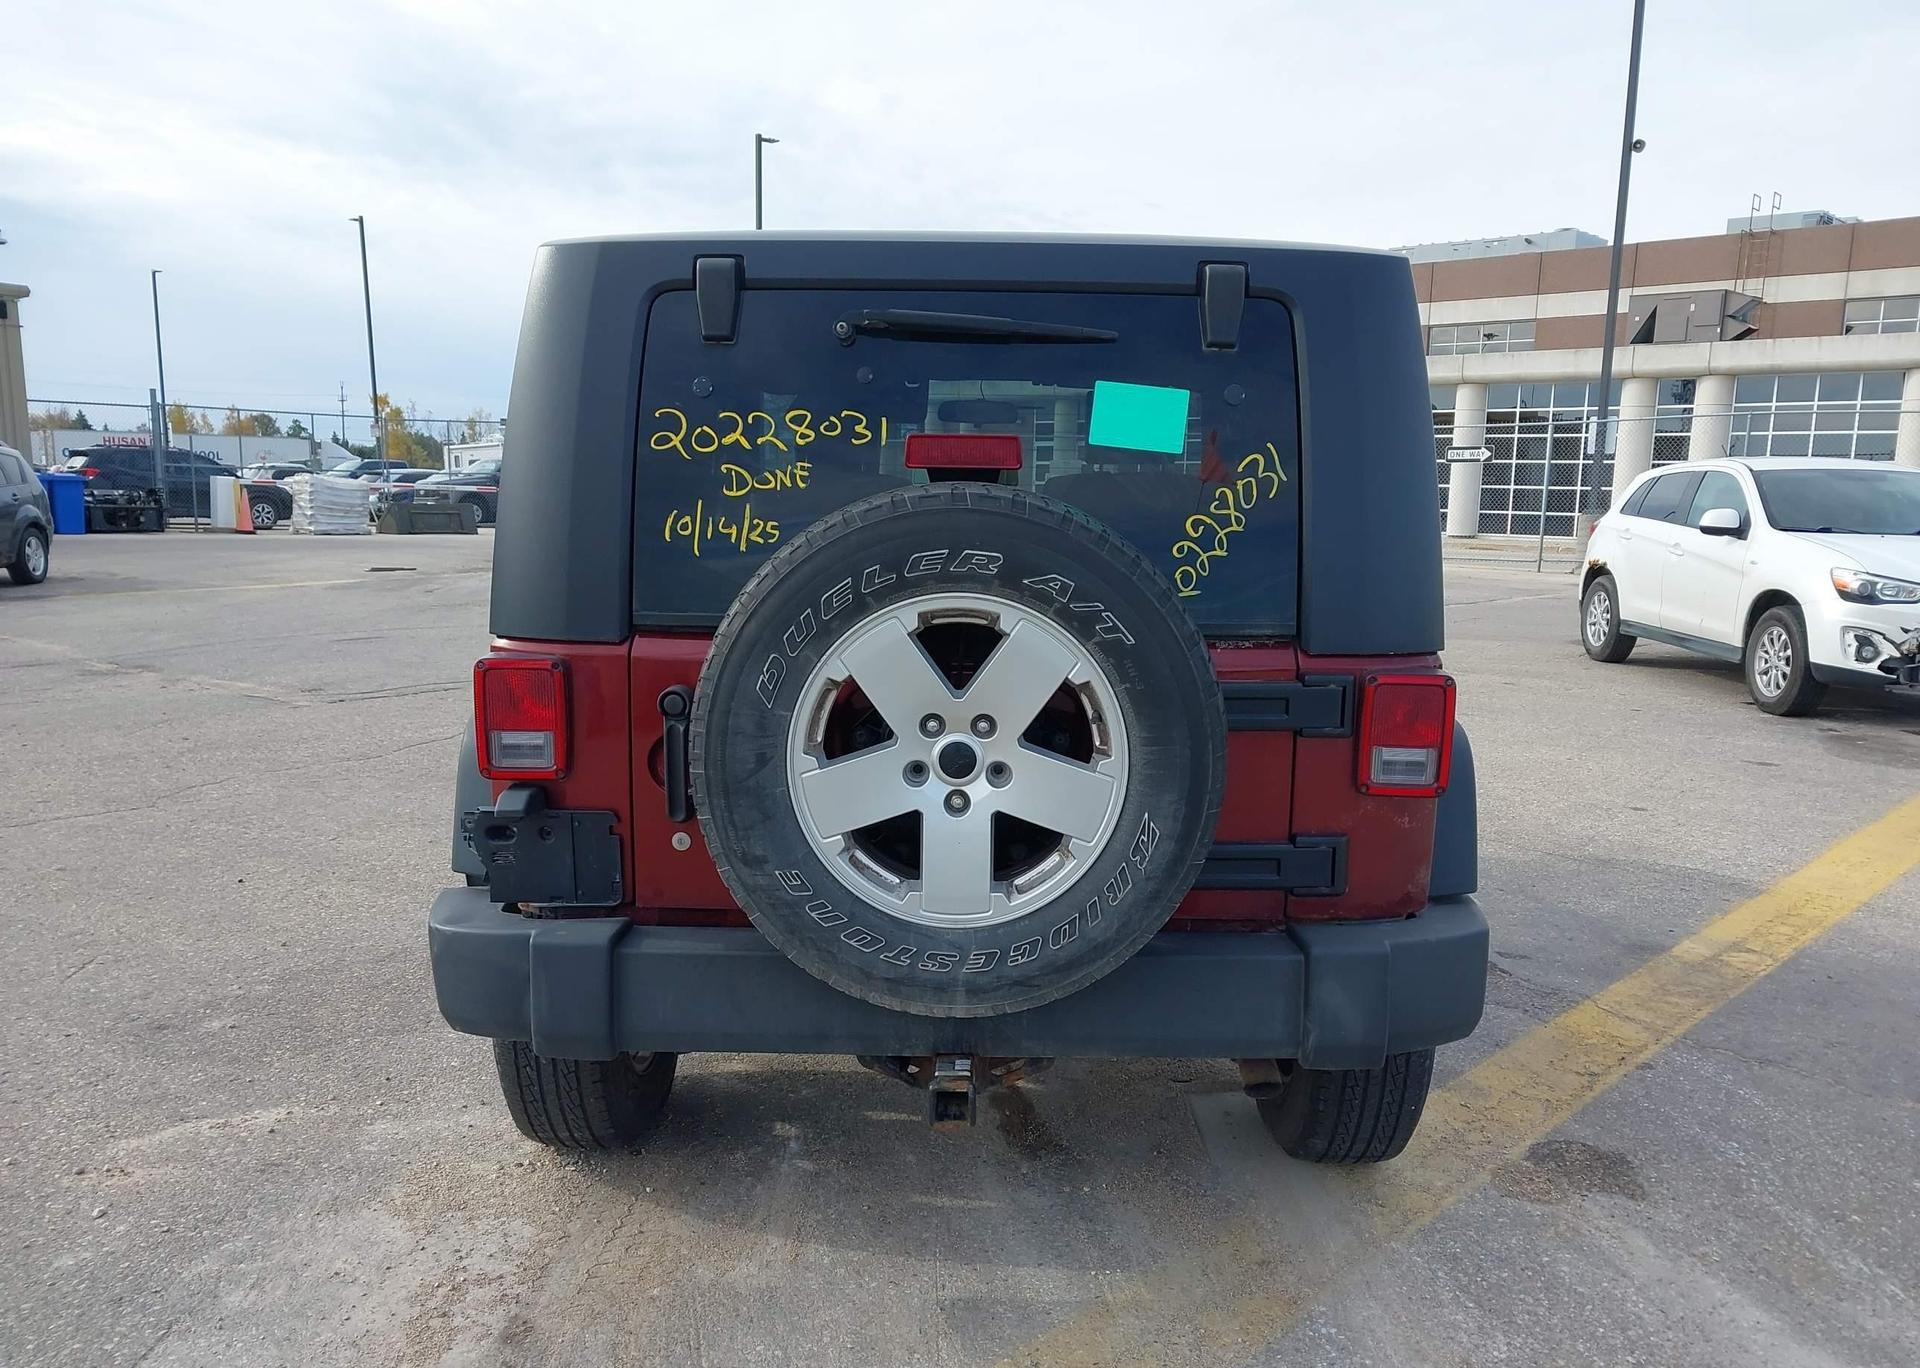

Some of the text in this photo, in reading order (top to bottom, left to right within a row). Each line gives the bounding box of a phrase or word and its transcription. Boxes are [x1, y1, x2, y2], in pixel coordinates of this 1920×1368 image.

[651, 408, 888, 460] 20228031
[1469, 450, 1486, 458] WAY
[720, 461, 812, 497] DONE
[664, 498, 780, 557] 10/14/25
[756, 549, 1005, 709] DUELER
[1022, 573, 1136, 648] A/T
[773, 812, 1160, 974] BRIDGESTONE
